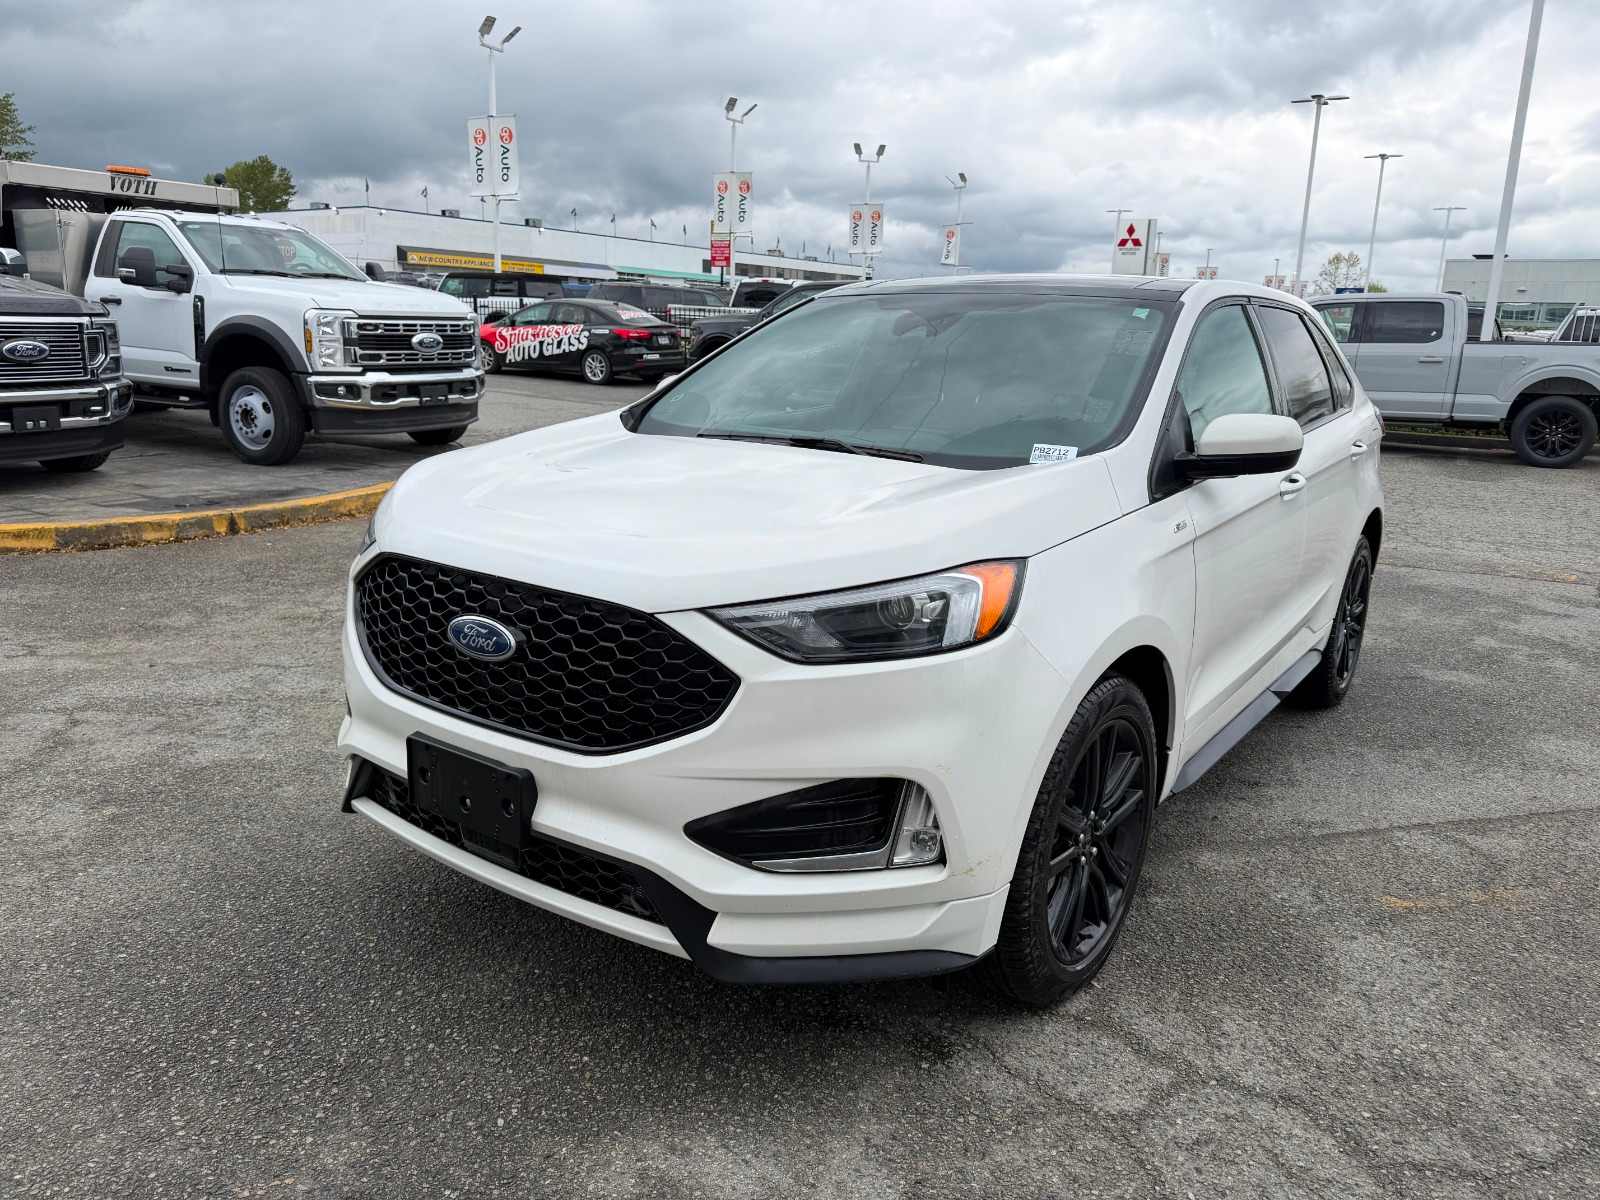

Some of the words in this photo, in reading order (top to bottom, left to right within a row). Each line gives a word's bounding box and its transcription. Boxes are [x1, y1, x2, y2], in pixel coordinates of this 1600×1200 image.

[474, 146, 484, 183] Auto
[500, 145, 511, 182] Auto
[111, 175, 158, 196] VOTH
[717, 194, 725, 223] Auto
[739, 194, 747, 223] Auto
[852, 222, 860, 246] Auto
[870, 222, 879, 246] Auto
[418, 255, 433, 264] NEW
[434, 257, 463, 266] COUNTRY
[506, 341, 540, 364] AUTO
[543, 331, 590, 357] GLASS
[1034, 447, 1069, 456] PB2712
[460, 623, 497, 651] Ford
